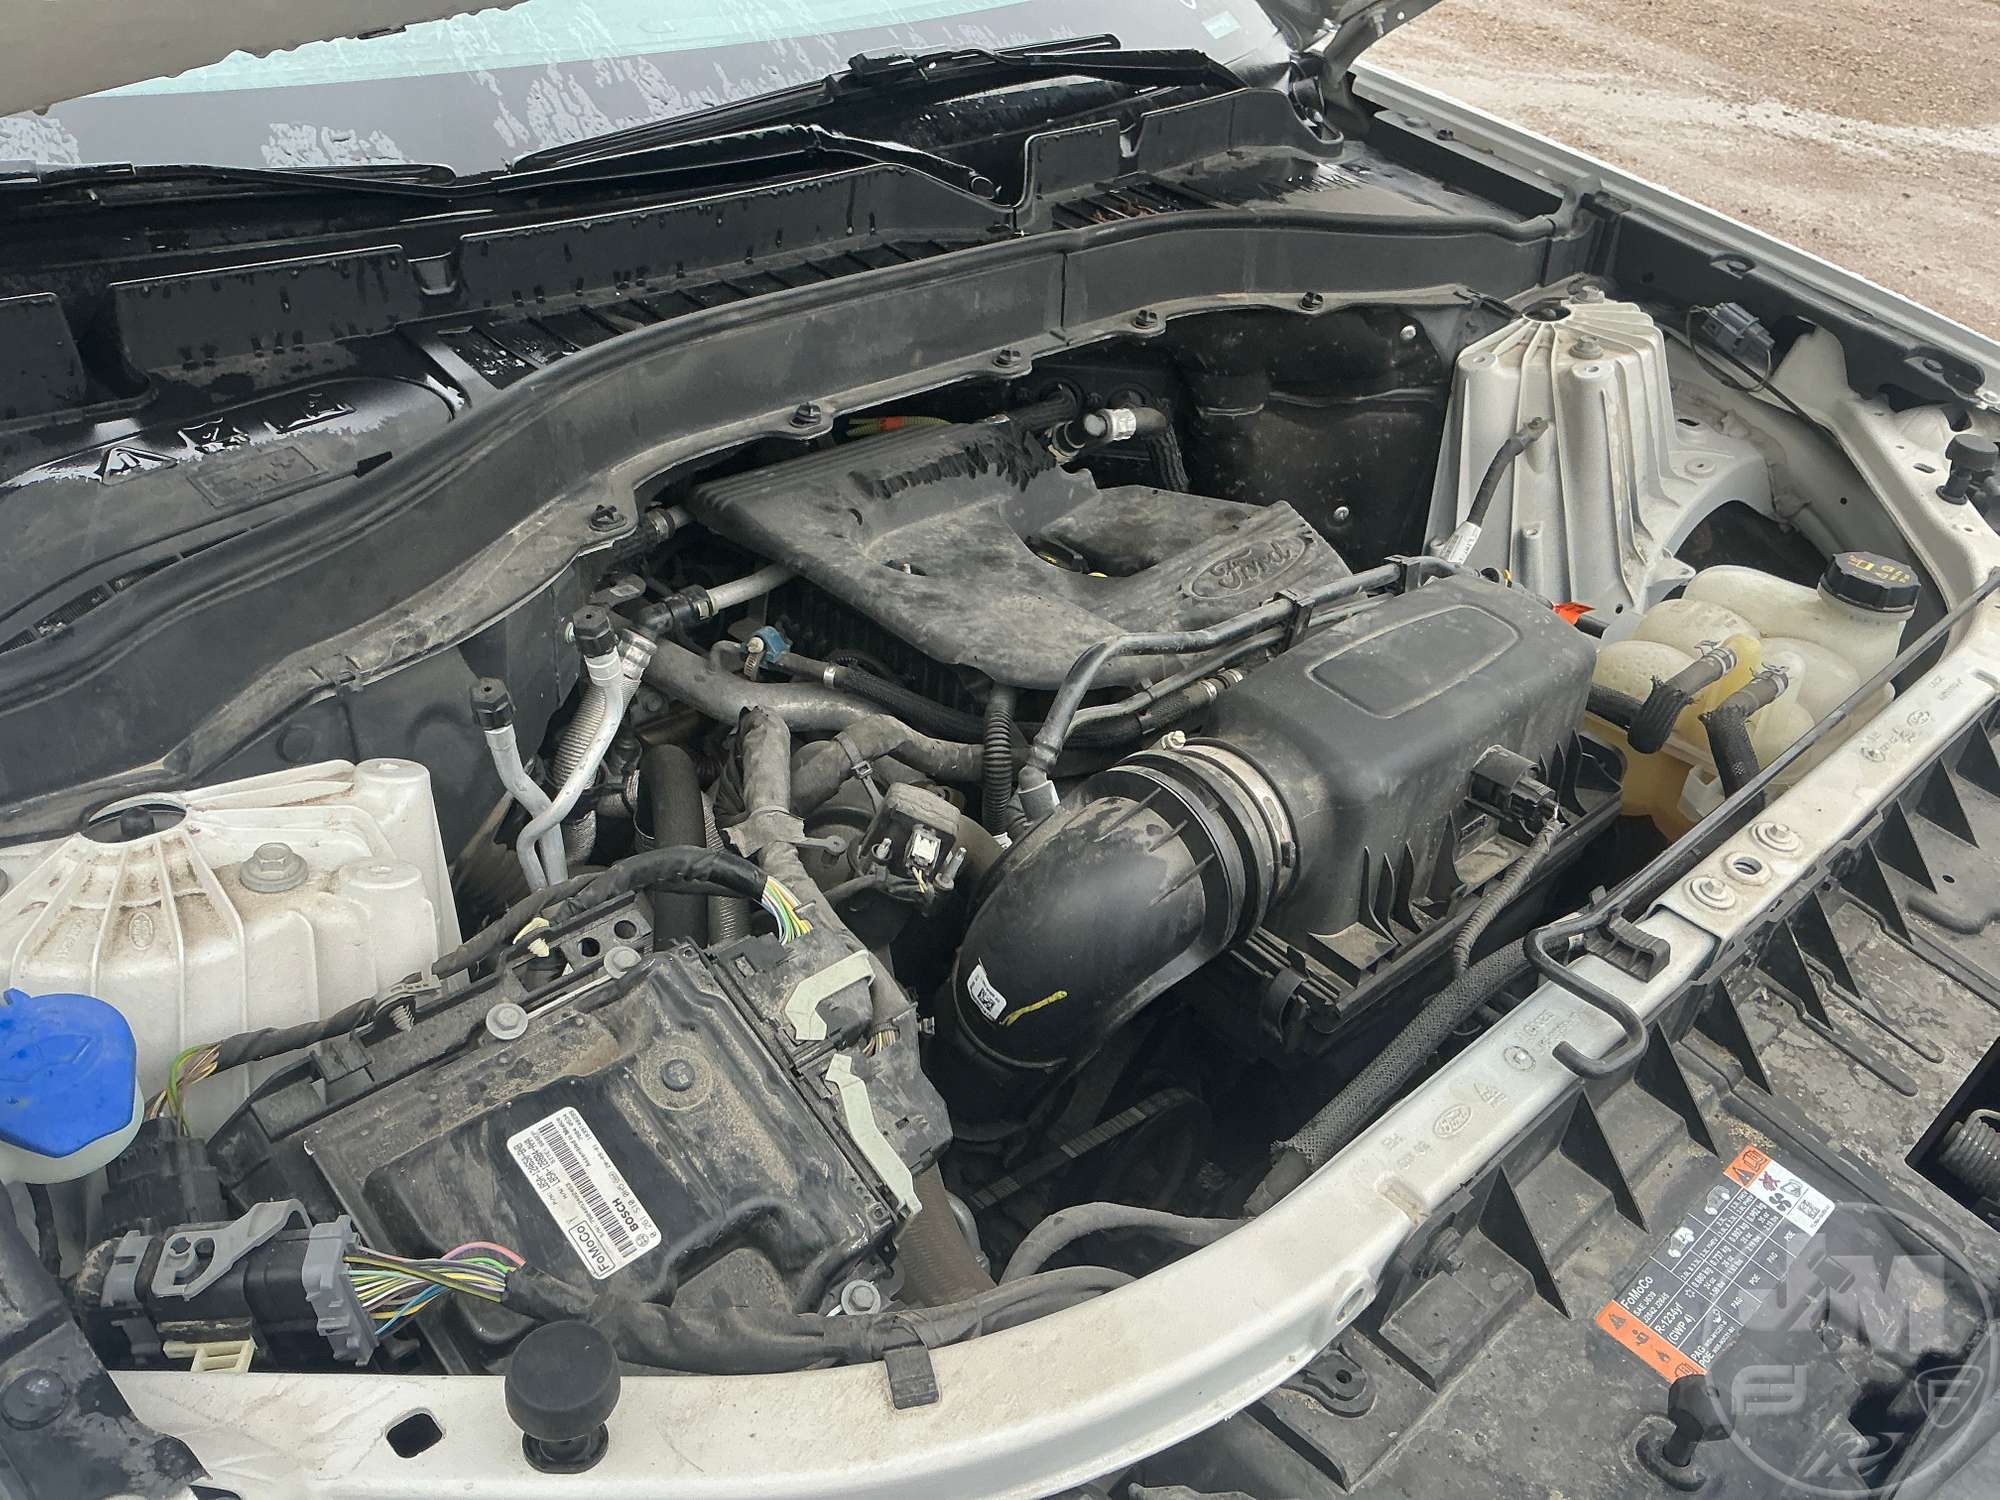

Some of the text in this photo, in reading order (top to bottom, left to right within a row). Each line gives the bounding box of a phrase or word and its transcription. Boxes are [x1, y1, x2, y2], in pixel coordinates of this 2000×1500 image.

[1211, 542, 1293, 590] Ford
[610, 1196, 640, 1232] BOSCH
[1782, 1229, 1796, 1242] POE
[572, 1223, 611, 1273] FoMoCo
[1765, 1250, 1779, 1264] PAG
[1747, 1272, 1761, 1286] POE
[1619, 1273, 1654, 1310] FoMoCo
[1632, 1302, 1646, 1317] SAE
[1729, 1294, 1744, 1309] PAG
[1653, 1301, 1686, 1336] R-1234yf
[1664, 1319, 1690, 1345] (GWP
[1689, 1343, 1706, 1362] PAG
[1697, 1349, 1715, 1368] POE
